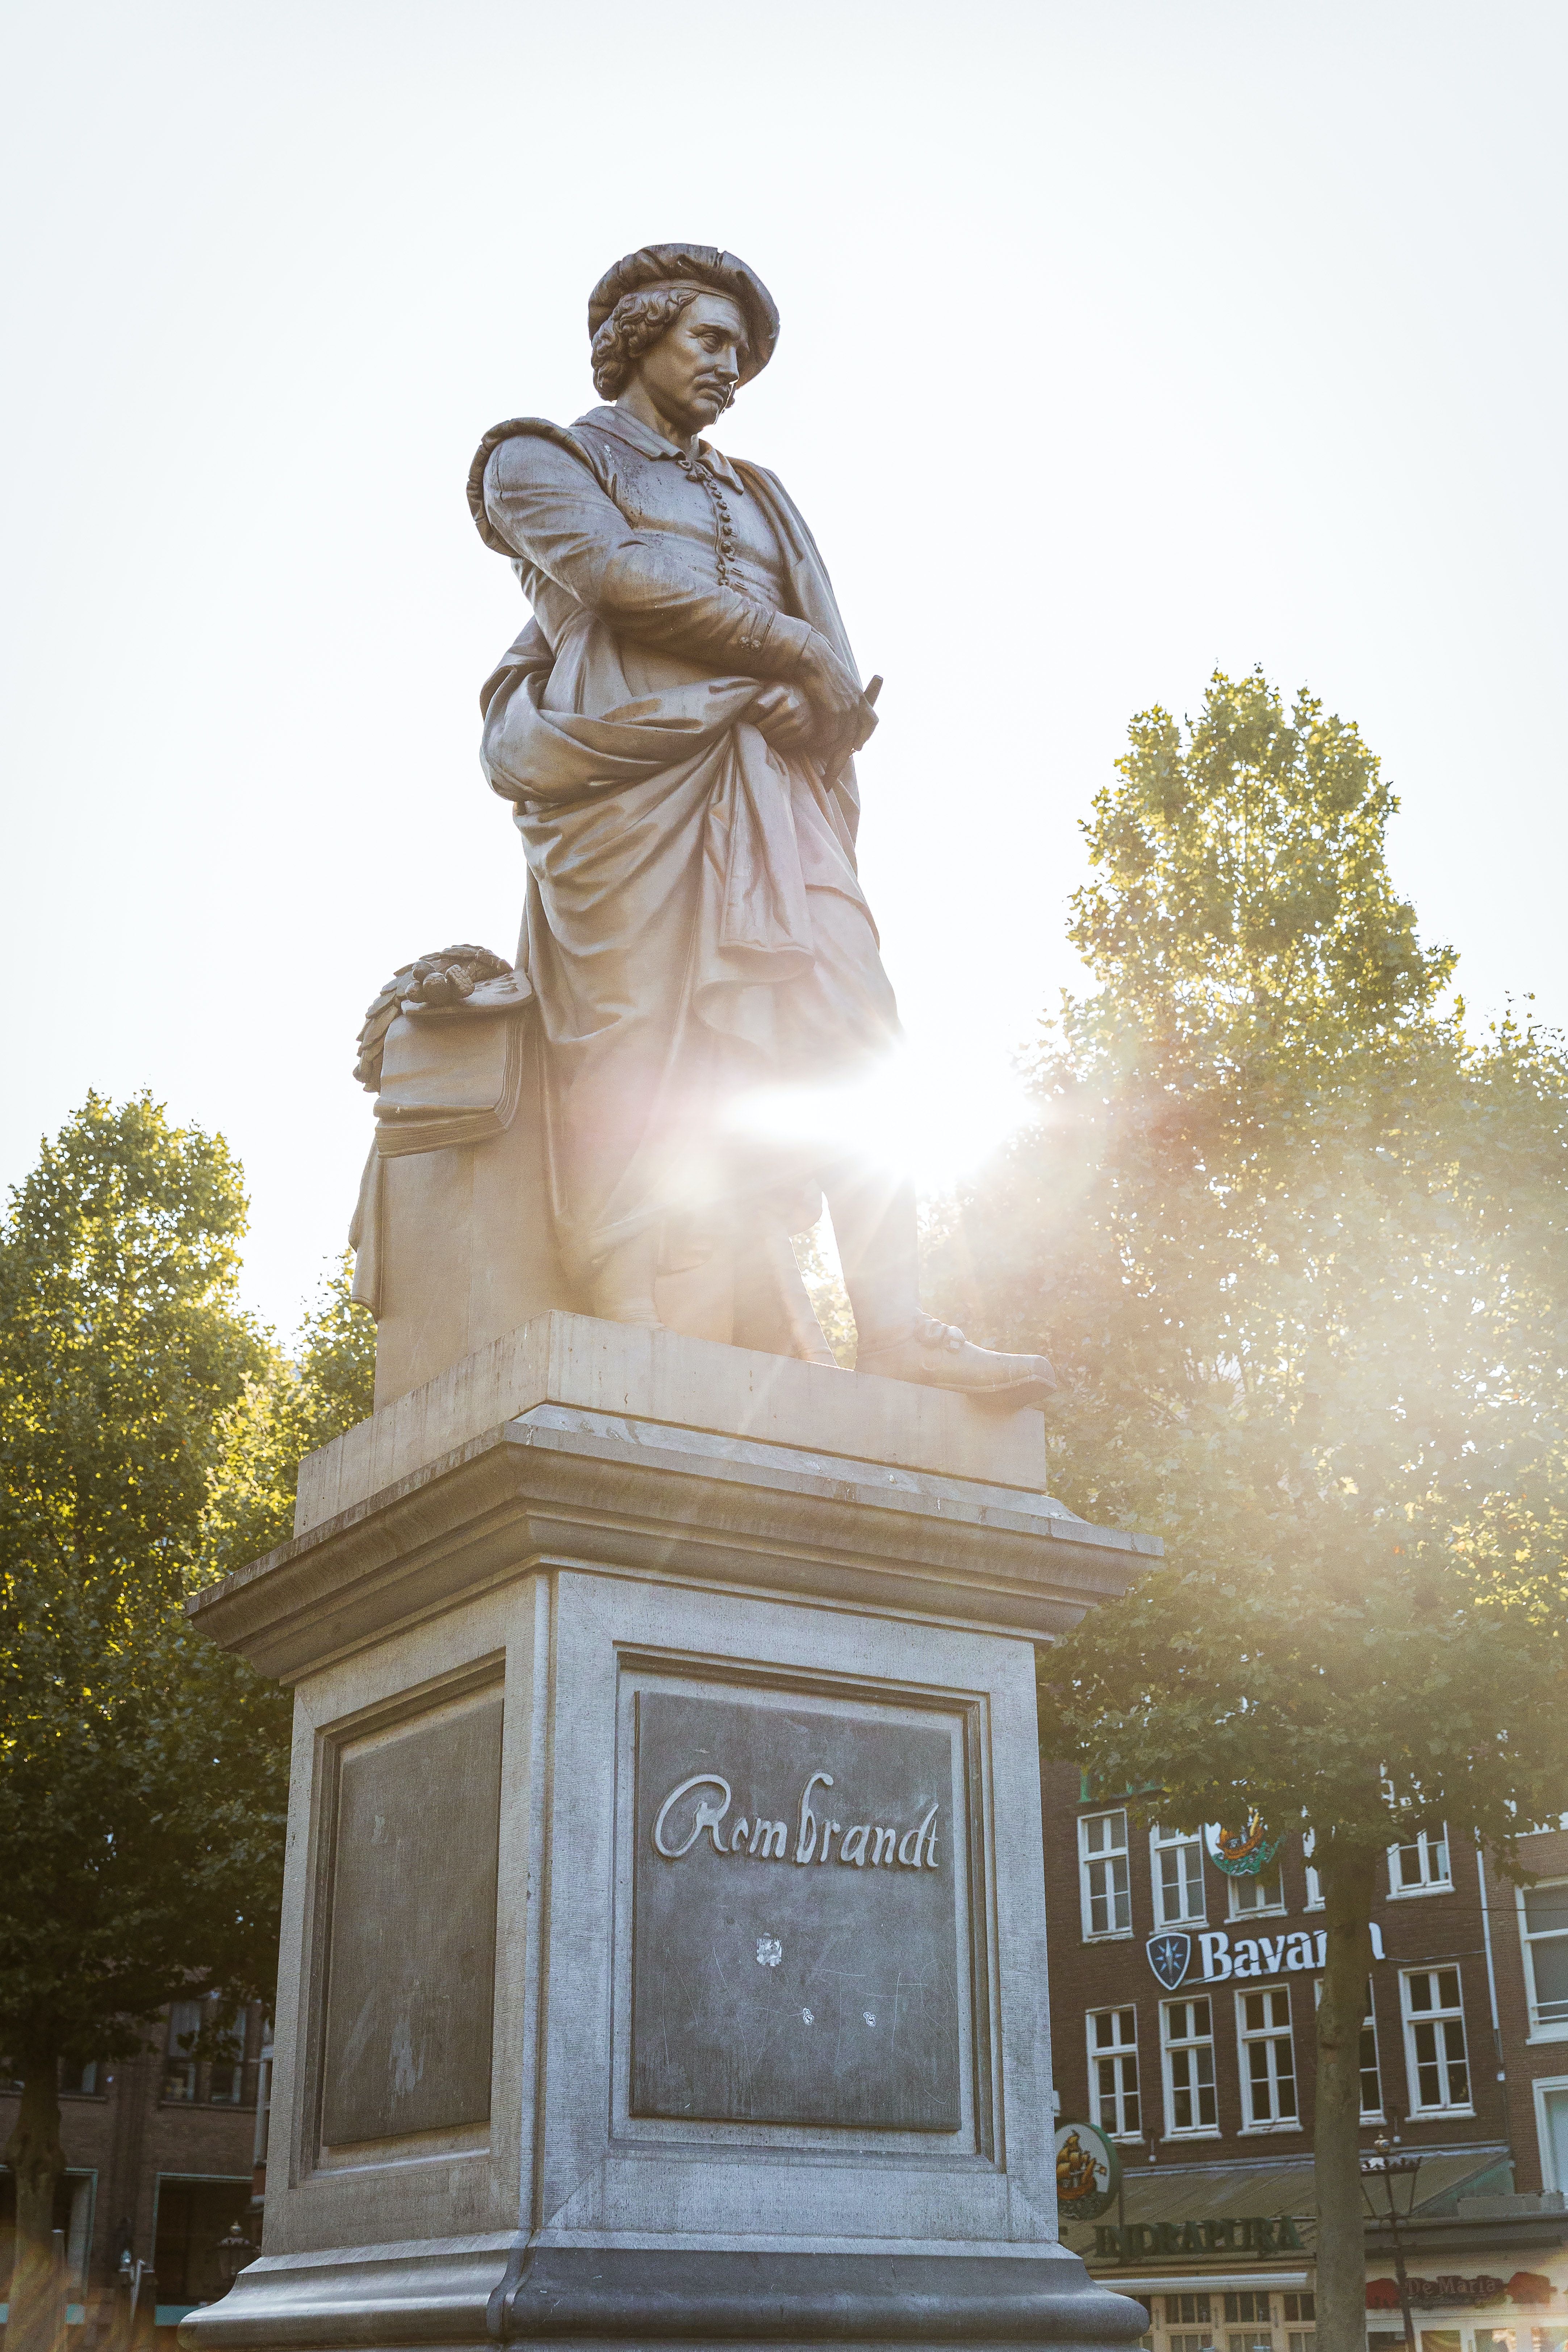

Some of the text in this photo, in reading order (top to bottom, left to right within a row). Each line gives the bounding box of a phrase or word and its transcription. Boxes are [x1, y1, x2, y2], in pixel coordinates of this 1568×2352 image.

[653, 1771, 939, 1868] Rembrandt
[1198, 1922, 1385, 1983] Bavar
[1093, 2215, 1305, 2257] INDRAPURA
